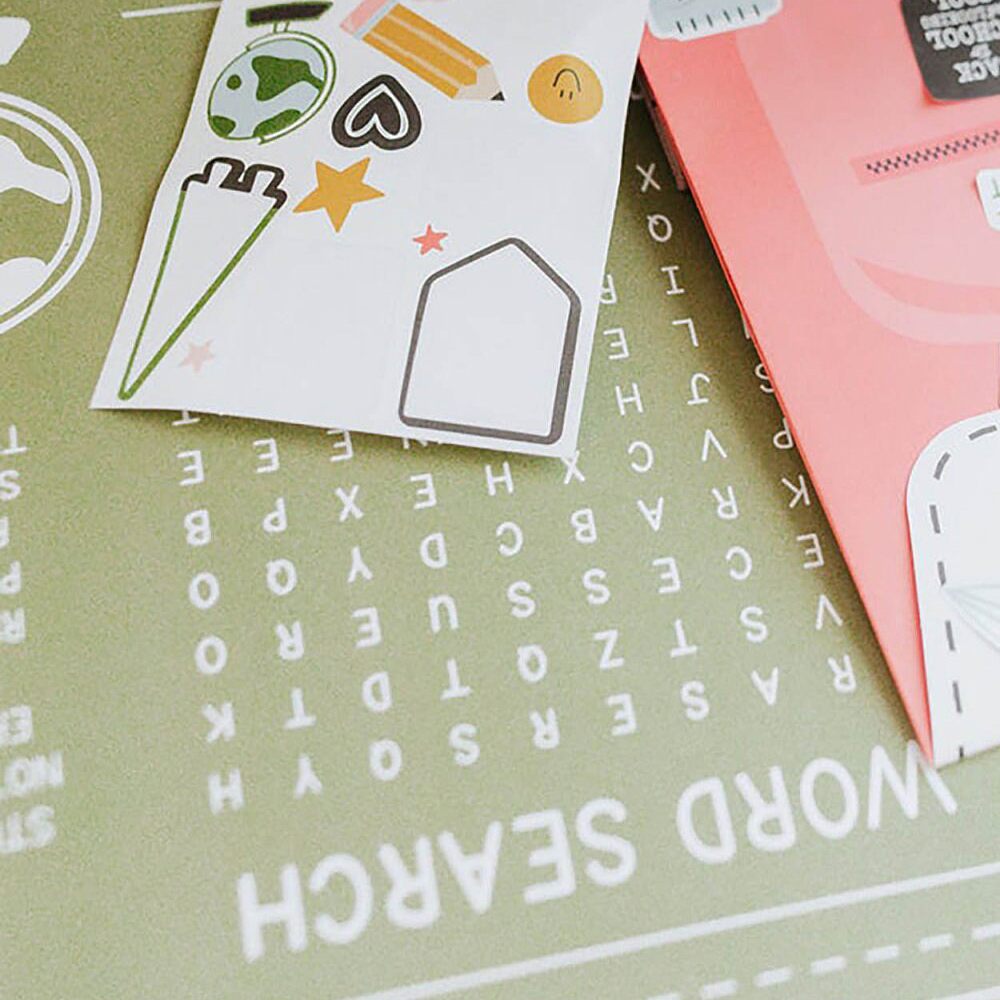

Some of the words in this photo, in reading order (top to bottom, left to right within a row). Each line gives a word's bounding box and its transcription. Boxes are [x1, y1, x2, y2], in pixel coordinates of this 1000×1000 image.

[637, 165, 659, 191] X
[648, 215, 671, 241] Q
[662, 267, 683, 294] I
[604, 329, 628, 359] E
[673, 319, 697, 346] L
[616, 383, 642, 415] H
[688, 374, 709, 404] J
[327, 429, 353, 462] E
[702, 430, 726, 461] V
[773, 418, 793, 449] P
[177, 450, 204, 485] E
[254, 439, 279, 472] E
[560, 450, 585, 485] X
[629, 442, 653, 472] C
[410, 475, 436, 509] E
[486, 464, 513, 495] H
[783, 477, 808, 506] K
[263, 497, 286, 534] P
[335, 485, 363, 521] X
[638, 498, 663, 530] A
[713, 486, 738, 519] R
[184, 510, 210, 545] B
[497, 523, 522, 555] C
[571, 509, 596, 543] B
[348, 547, 372, 582] Y
[420, 533, 447, 567] D
[726, 547, 751, 579] C
[798, 535, 822, 567] E
[189, 571, 219, 609] O
[267, 560, 297, 595] Q
[583, 569, 609, 603] S
[653, 558, 680, 592] E
[429, 595, 458, 632] U
[508, 582, 534, 617] S
[817, 596, 841, 629] V
[276, 622, 303, 659] R
[352, 608, 380, 647] E
[671, 620, 696, 656] T
[741, 607, 767, 642] S
[196, 636, 226, 674] O
[518, 645, 546, 681] Q
[594, 631, 623, 669] Z
[441, 660, 471, 699] T
[752, 669, 778, 704] A
[829, 656, 855, 691] R
[285, 689, 315, 728] T
[363, 672, 391, 712] D
[681, 682, 708, 719] S
[203, 703, 234, 742] K
[530, 709, 559, 748] R
[607, 695, 636, 735] E
[370, 740, 401, 780] Q
[449, 725, 479, 765] S
[209, 770, 243, 813] H
[295, 755, 321, 797] Y
[676, 740, 958, 864] WORD
[237, 798, 636, 963] SEARCH
